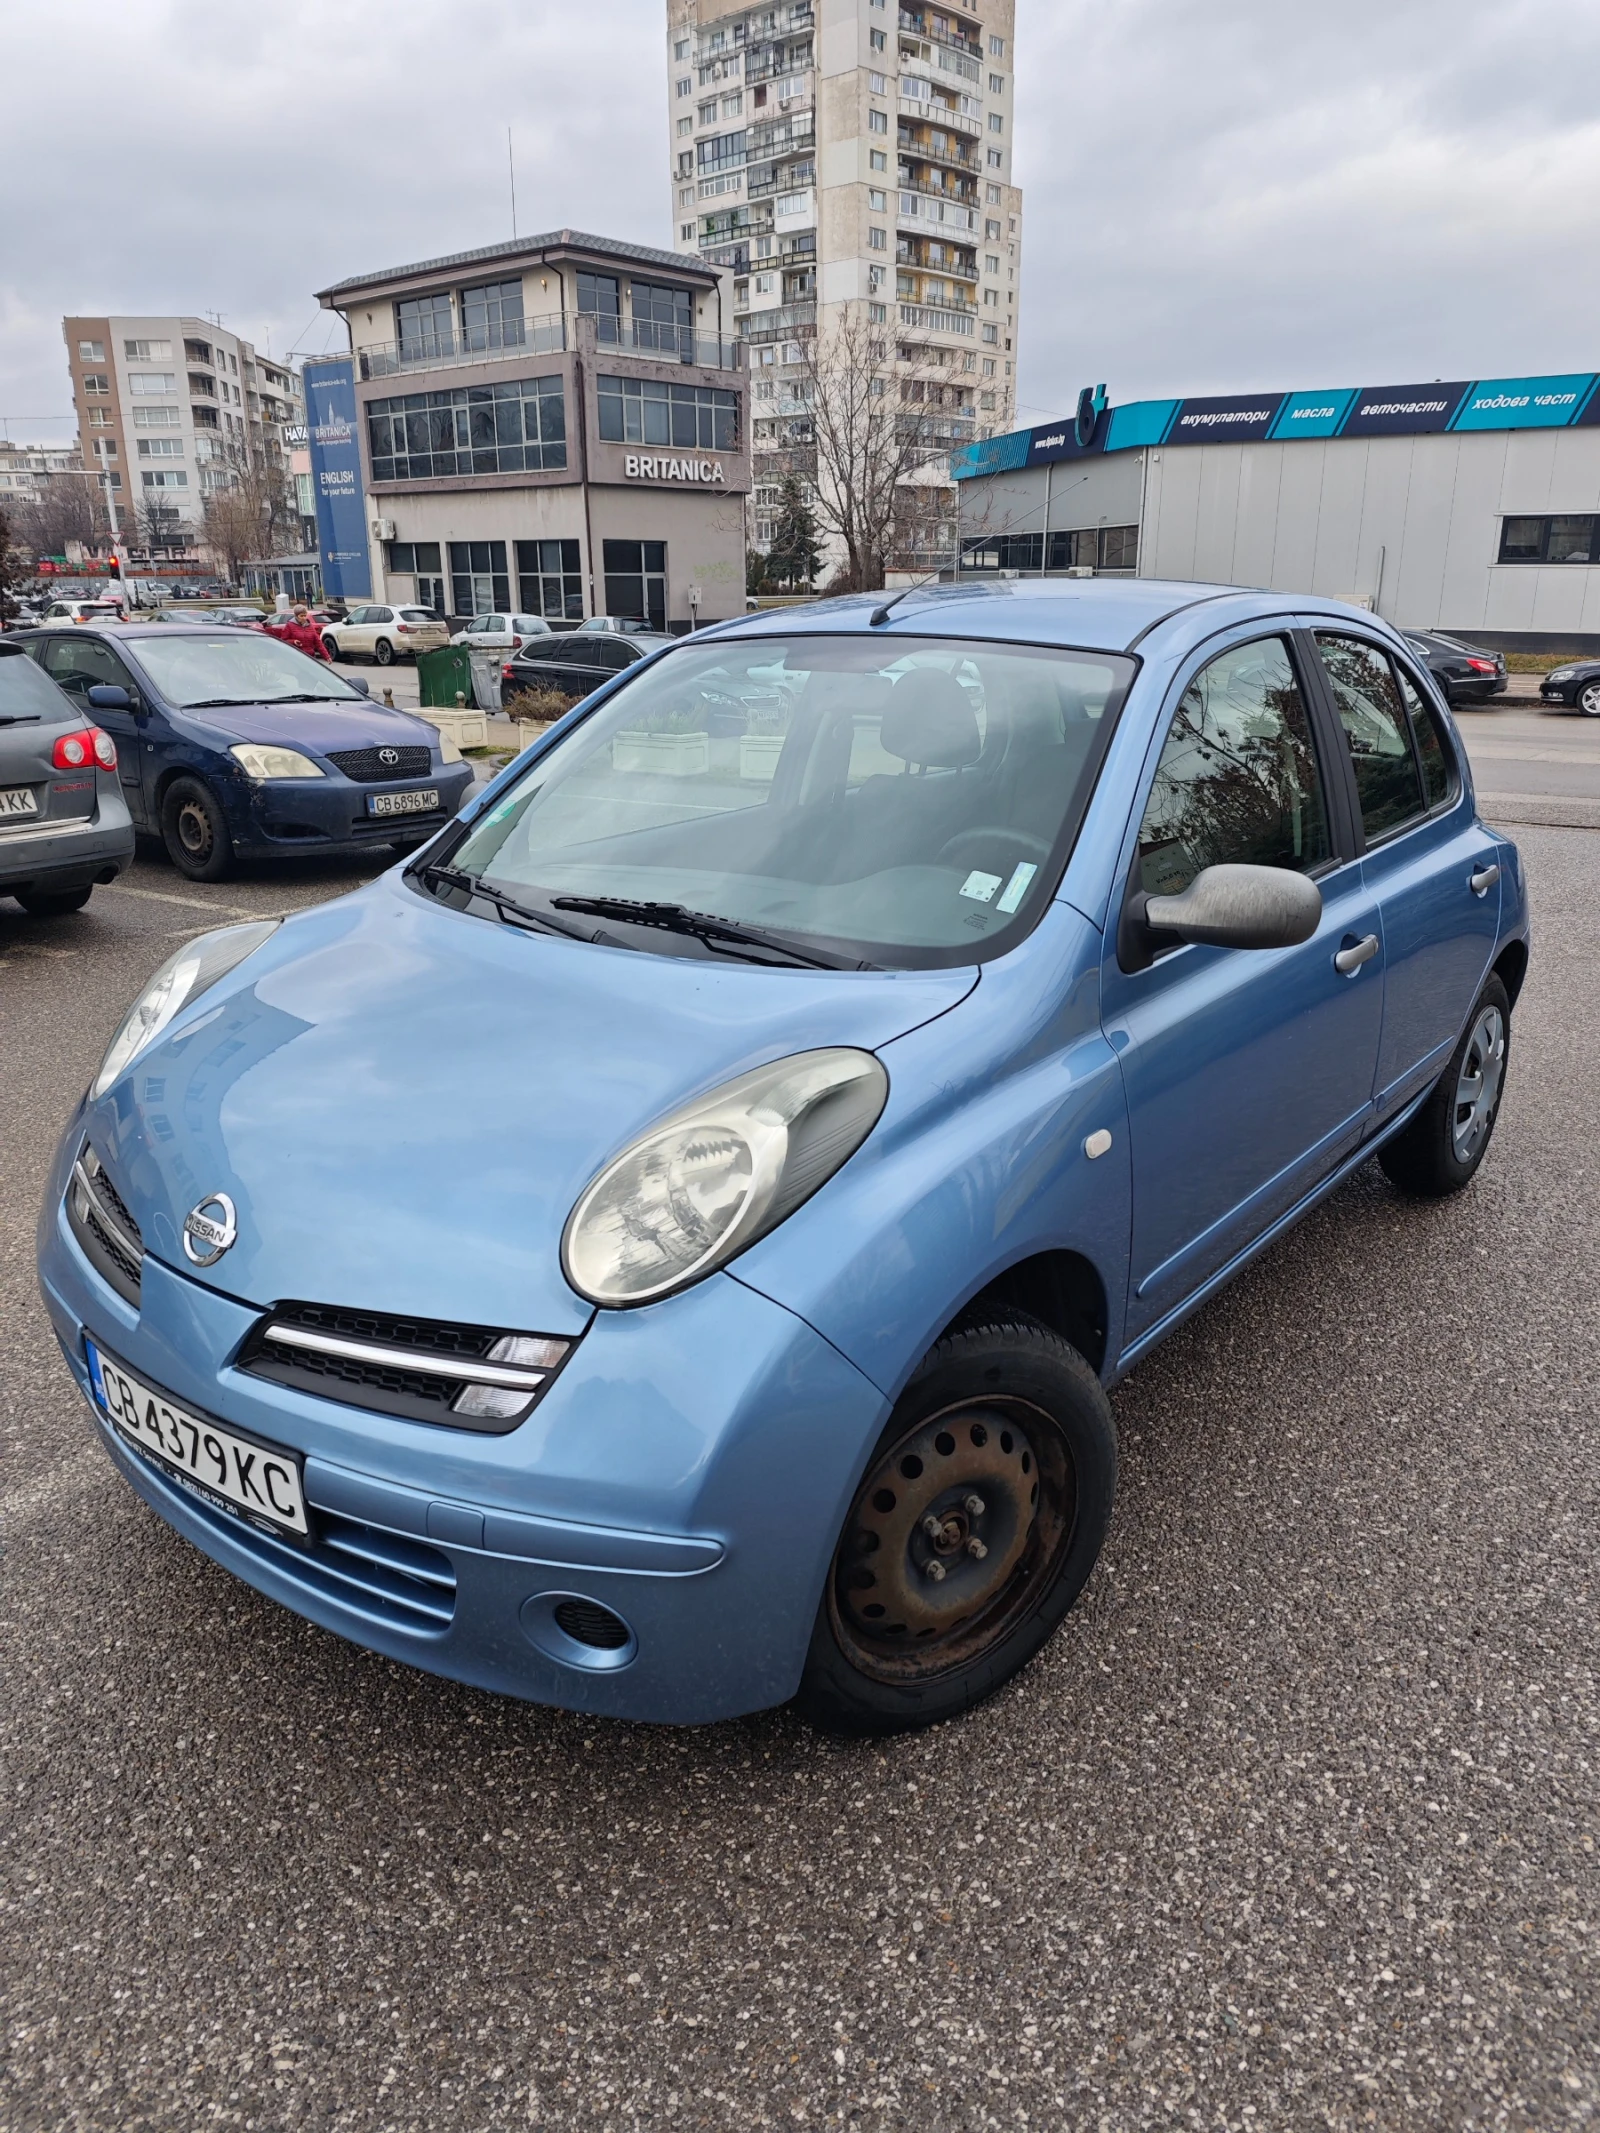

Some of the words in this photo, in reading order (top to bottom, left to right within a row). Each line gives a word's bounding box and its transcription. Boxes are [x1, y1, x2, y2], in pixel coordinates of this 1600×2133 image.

[1360, 401, 1448, 416] авточасти
[1471, 394, 1530, 410] ходова
[1534, 393, 1577, 406] част
[1180, 410, 1270, 428] акумулатори
[1291, 406, 1335, 419] масла
[625, 455, 725, 482] BRITANICA
[320, 470, 354, 485] ENGLISH
[321, 488, 329, 496] for
[329, 488, 340, 497] your
[340, 486, 355, 495] future
[186, 1214, 226, 1243] NISSAN
